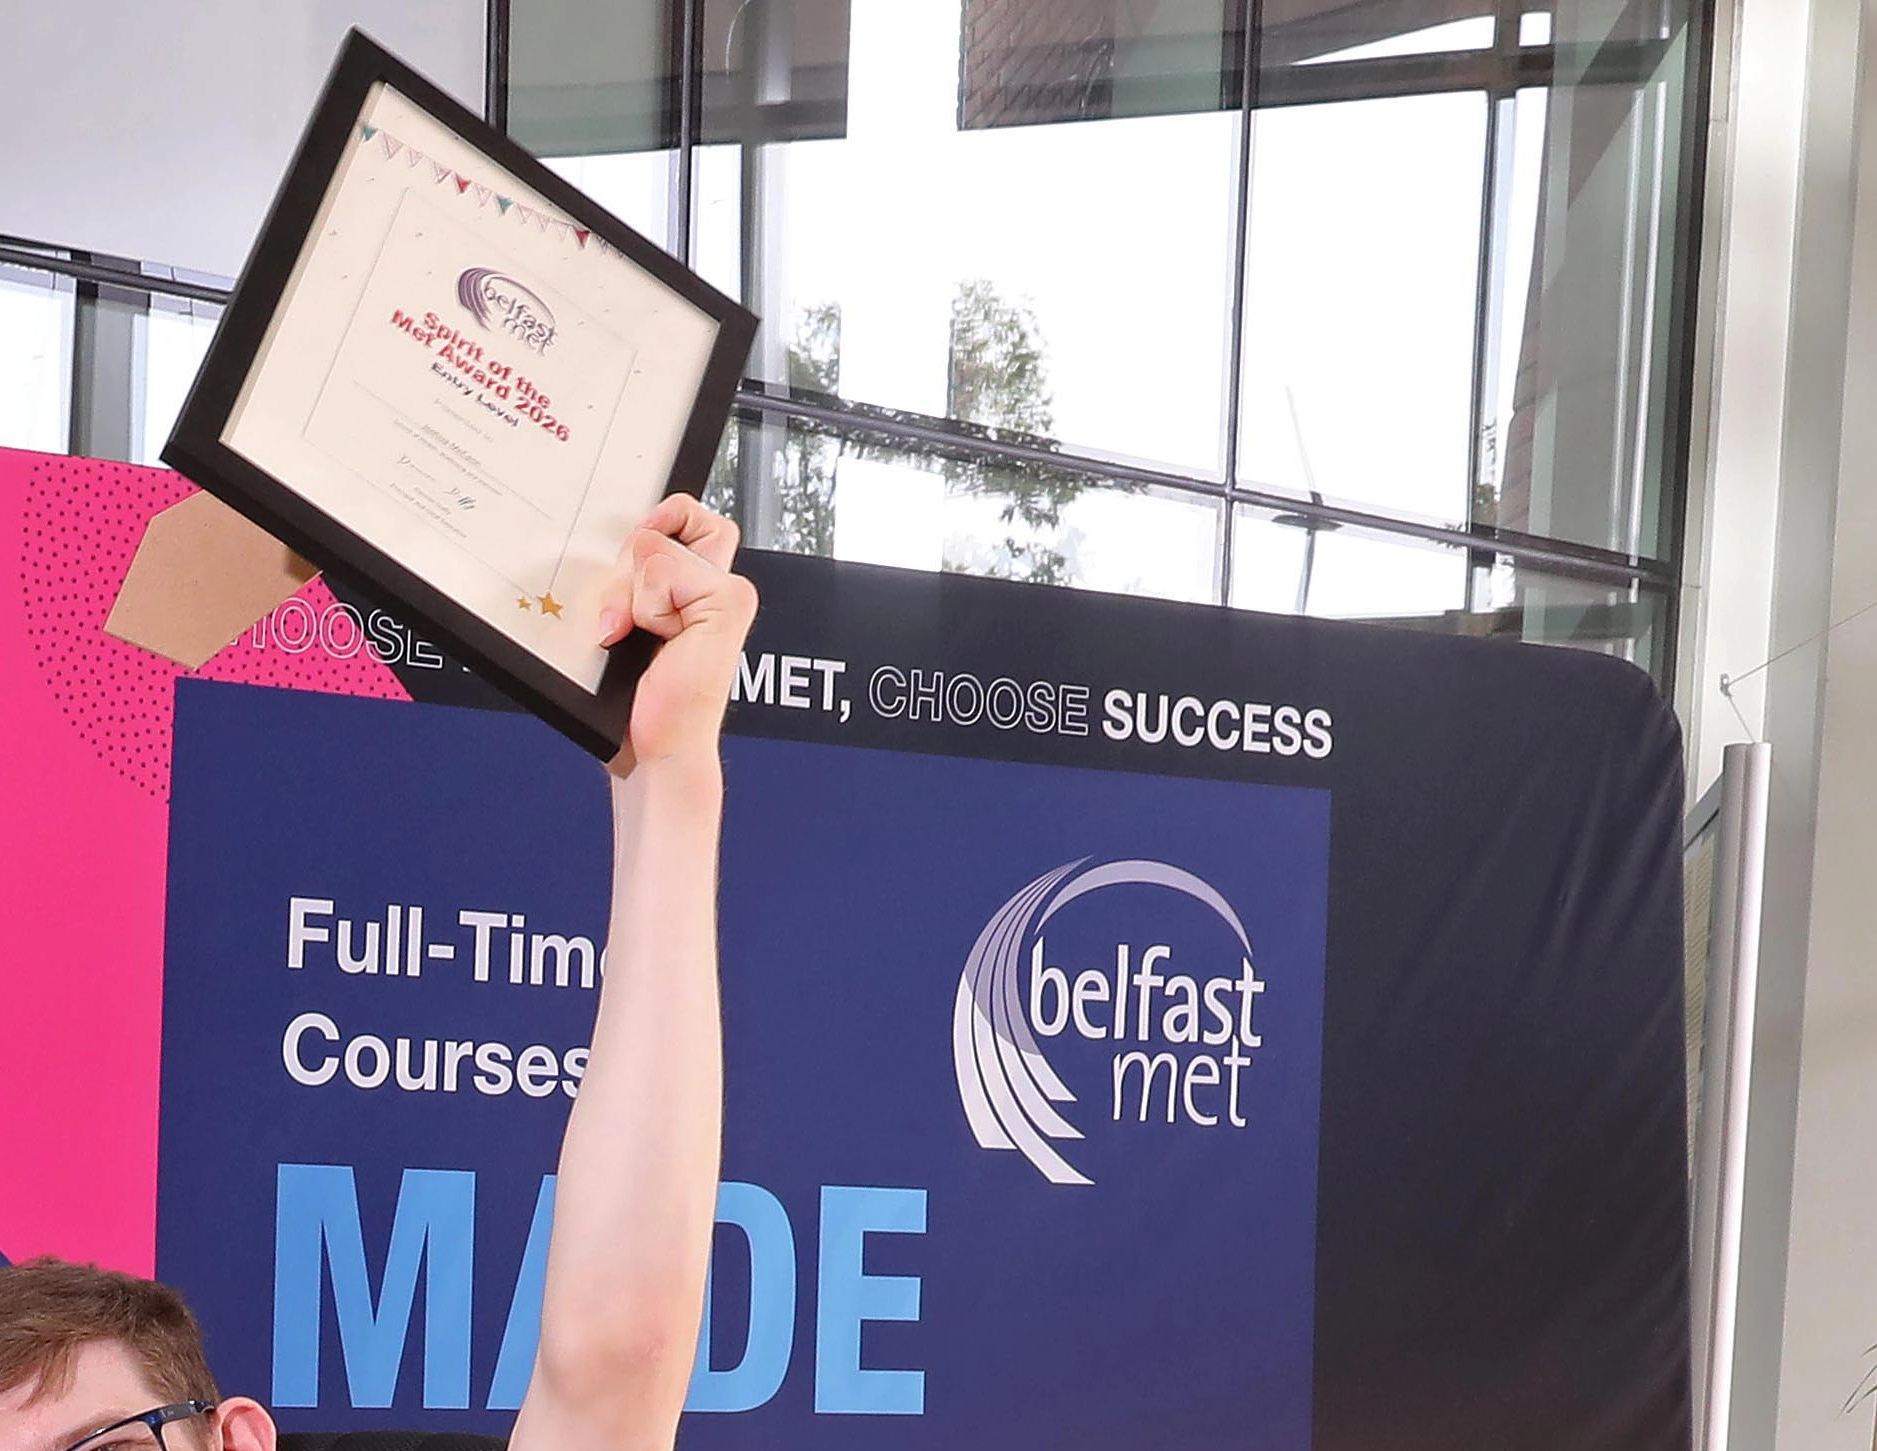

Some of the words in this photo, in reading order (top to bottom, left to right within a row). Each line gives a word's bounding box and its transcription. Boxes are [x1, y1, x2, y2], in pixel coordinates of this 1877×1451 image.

[391, 308, 437, 348] Met
[438, 344, 512, 400] Award
[514, 395, 571, 442] 2026
[424, 311, 485, 362] Spirit
[488, 359, 514, 382] of
[516, 376, 551, 409] the
[431, 362, 473, 396] Entry
[476, 392, 520, 428] Level
[230, 597, 443, 669] OOSE
[869, 664, 1090, 735] CHOOSE
[1103, 689, 1333, 758] SUCCESS
[287, 896, 606, 989] Full-Tim
[1030, 936, 1265, 1047] belfast
[1113, 1034, 1251, 1127] met
